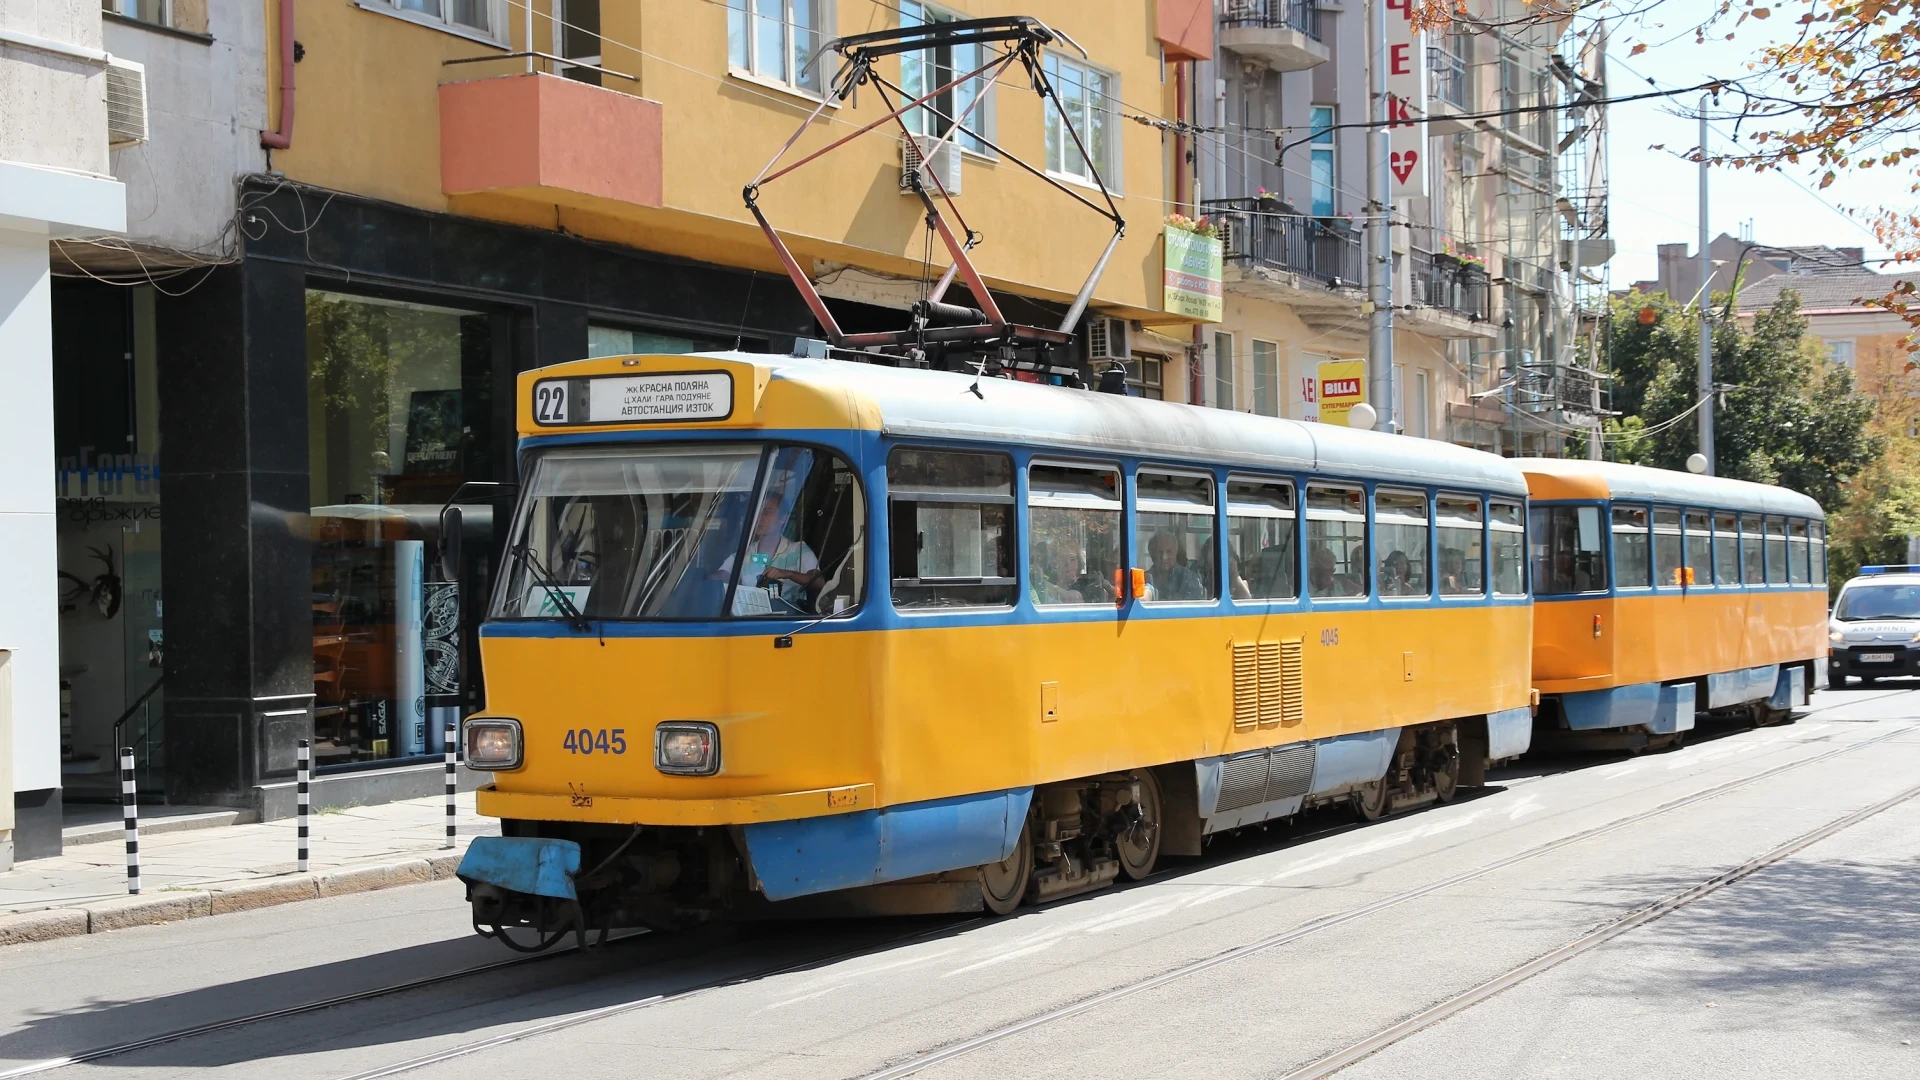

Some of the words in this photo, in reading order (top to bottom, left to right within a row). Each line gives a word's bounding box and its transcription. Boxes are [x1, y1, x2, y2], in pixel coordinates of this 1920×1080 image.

[1181, 253, 1208, 271] КАБИНЕТ
[639, 382, 672, 393] КРАСНА
[674, 380, 709, 391] ПОЛЯНА
[1324, 381, 1358, 395] BILLA
[538, 387, 566, 421] 22
[655, 394, 675, 402] ГАРА
[676, 392, 711, 402] ПОДУЯНЕ
[621, 404, 684, 416] АВТОСТАНЦИЯ
[686, 402, 714, 413] ИЗТОК
[407, 450, 457, 461] DEPLOYMENT
[1321, 628, 1339, 646] 4045
[378, 699, 387, 735] SAGA
[563, 728, 627, 755] 4045
